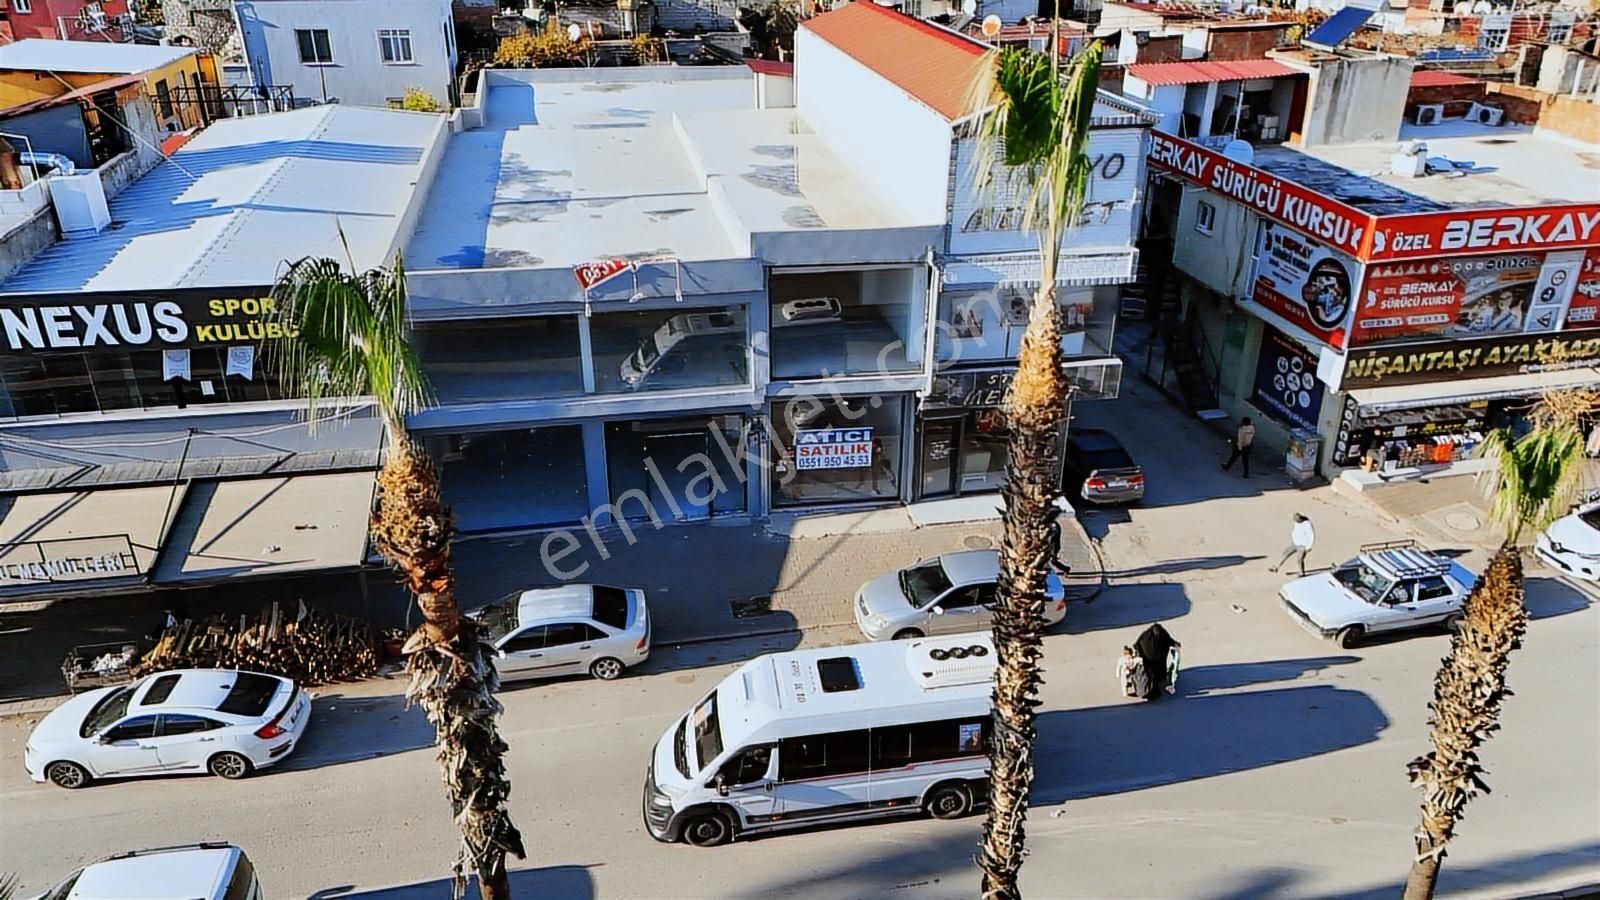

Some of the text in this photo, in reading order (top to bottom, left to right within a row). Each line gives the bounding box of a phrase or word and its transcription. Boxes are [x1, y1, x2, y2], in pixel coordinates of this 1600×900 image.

[1149, 133, 1210, 178] ERKAY
[1211, 162, 1281, 213] SÜRÜCÜ
[1282, 194, 1349, 245] KURSU
[1391, 212, 1600, 251] ÖZEL BERKAY
[1399, 281, 1458, 295] BERKAY
[208, 297, 277, 316] SPOR
[0, 301, 188, 349] NEXUS
[1345, 349, 1482, 381] NİŞANTAŞI
[800, 431, 870, 443] ATICI
[800, 444, 868, 456] SATILIK
[799, 455, 869, 467] 0551 950 45 53
